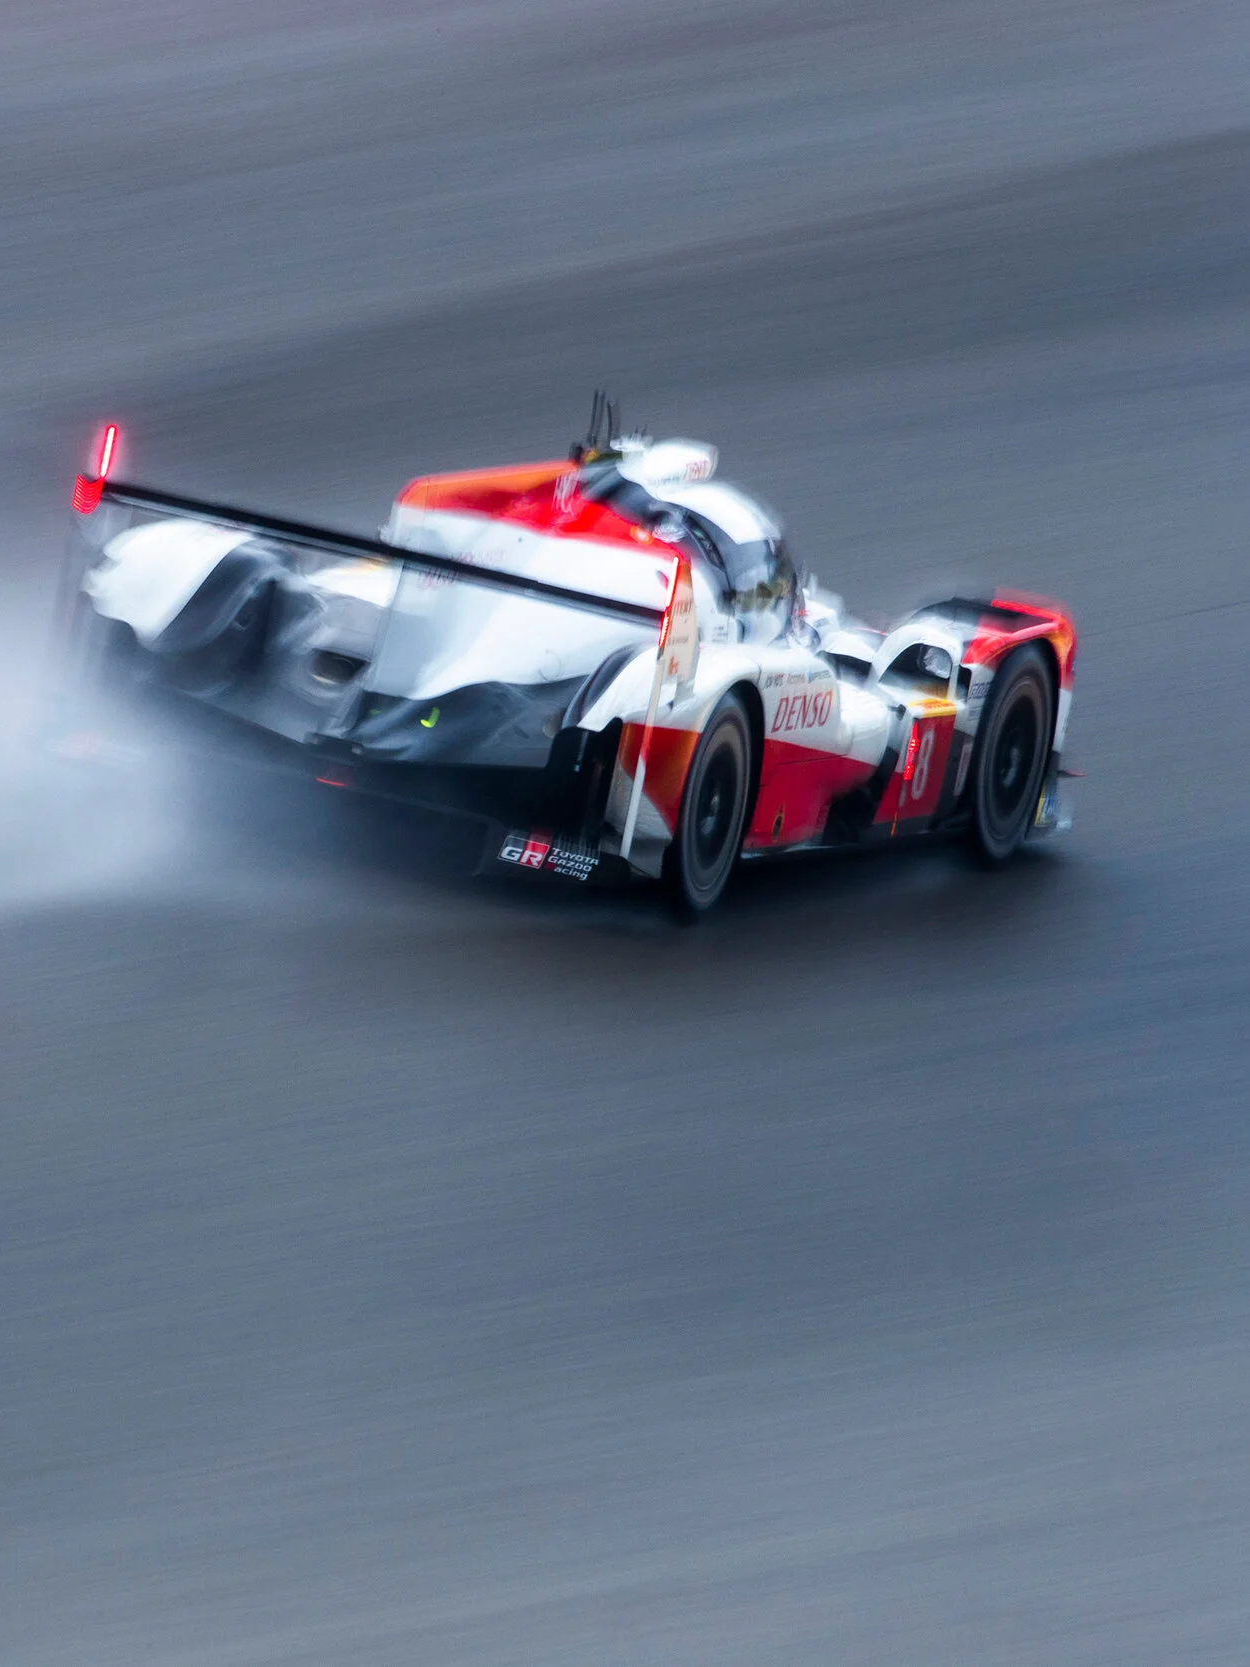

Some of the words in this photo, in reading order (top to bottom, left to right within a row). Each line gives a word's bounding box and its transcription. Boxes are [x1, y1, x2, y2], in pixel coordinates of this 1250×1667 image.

[771, 690, 833, 733] DENSO
[911, 729, 935, 800] 8
[500, 846, 543, 867] GR
[547, 855, 592, 872] GAZOO
[552, 847, 599, 866] TOYOTA
[544, 862, 589, 881] acing
